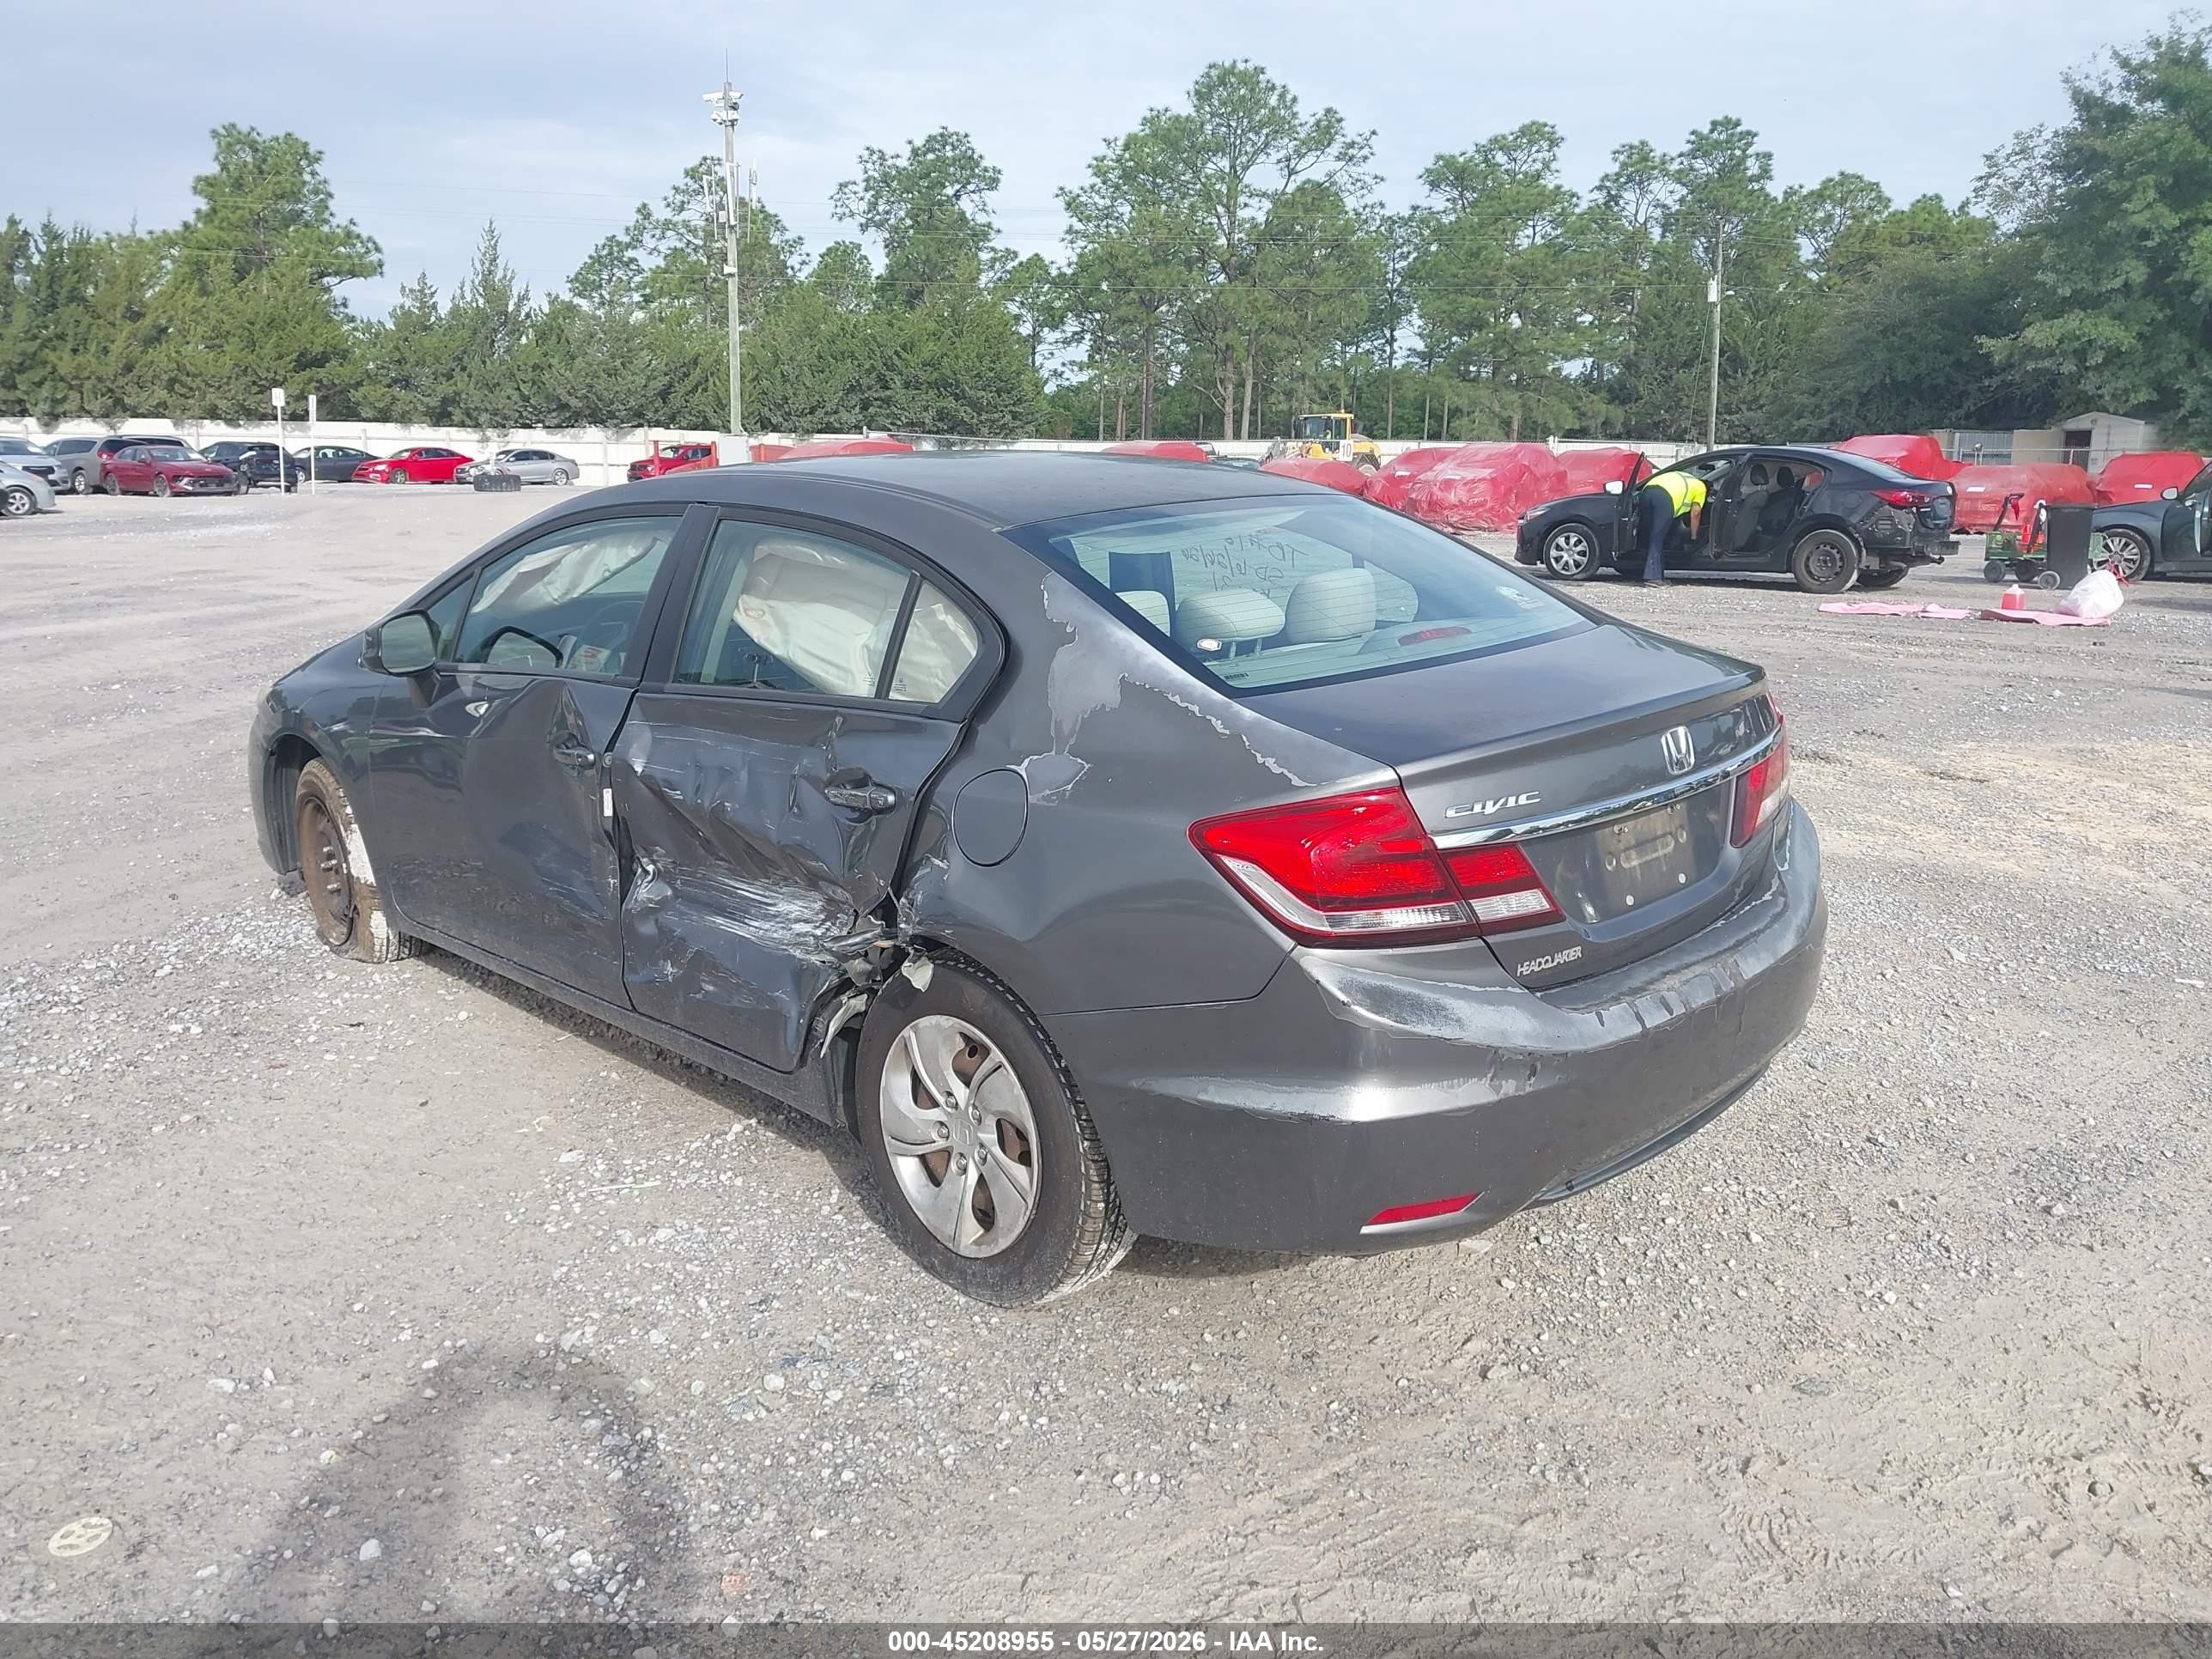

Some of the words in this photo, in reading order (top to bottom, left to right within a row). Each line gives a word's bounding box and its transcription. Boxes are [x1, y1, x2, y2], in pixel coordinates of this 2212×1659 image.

[1341, 442, 1352, 458] 10
[1445, 790, 1542, 819] CIVIC
[1516, 945, 1583, 977] HEADQUARTER
